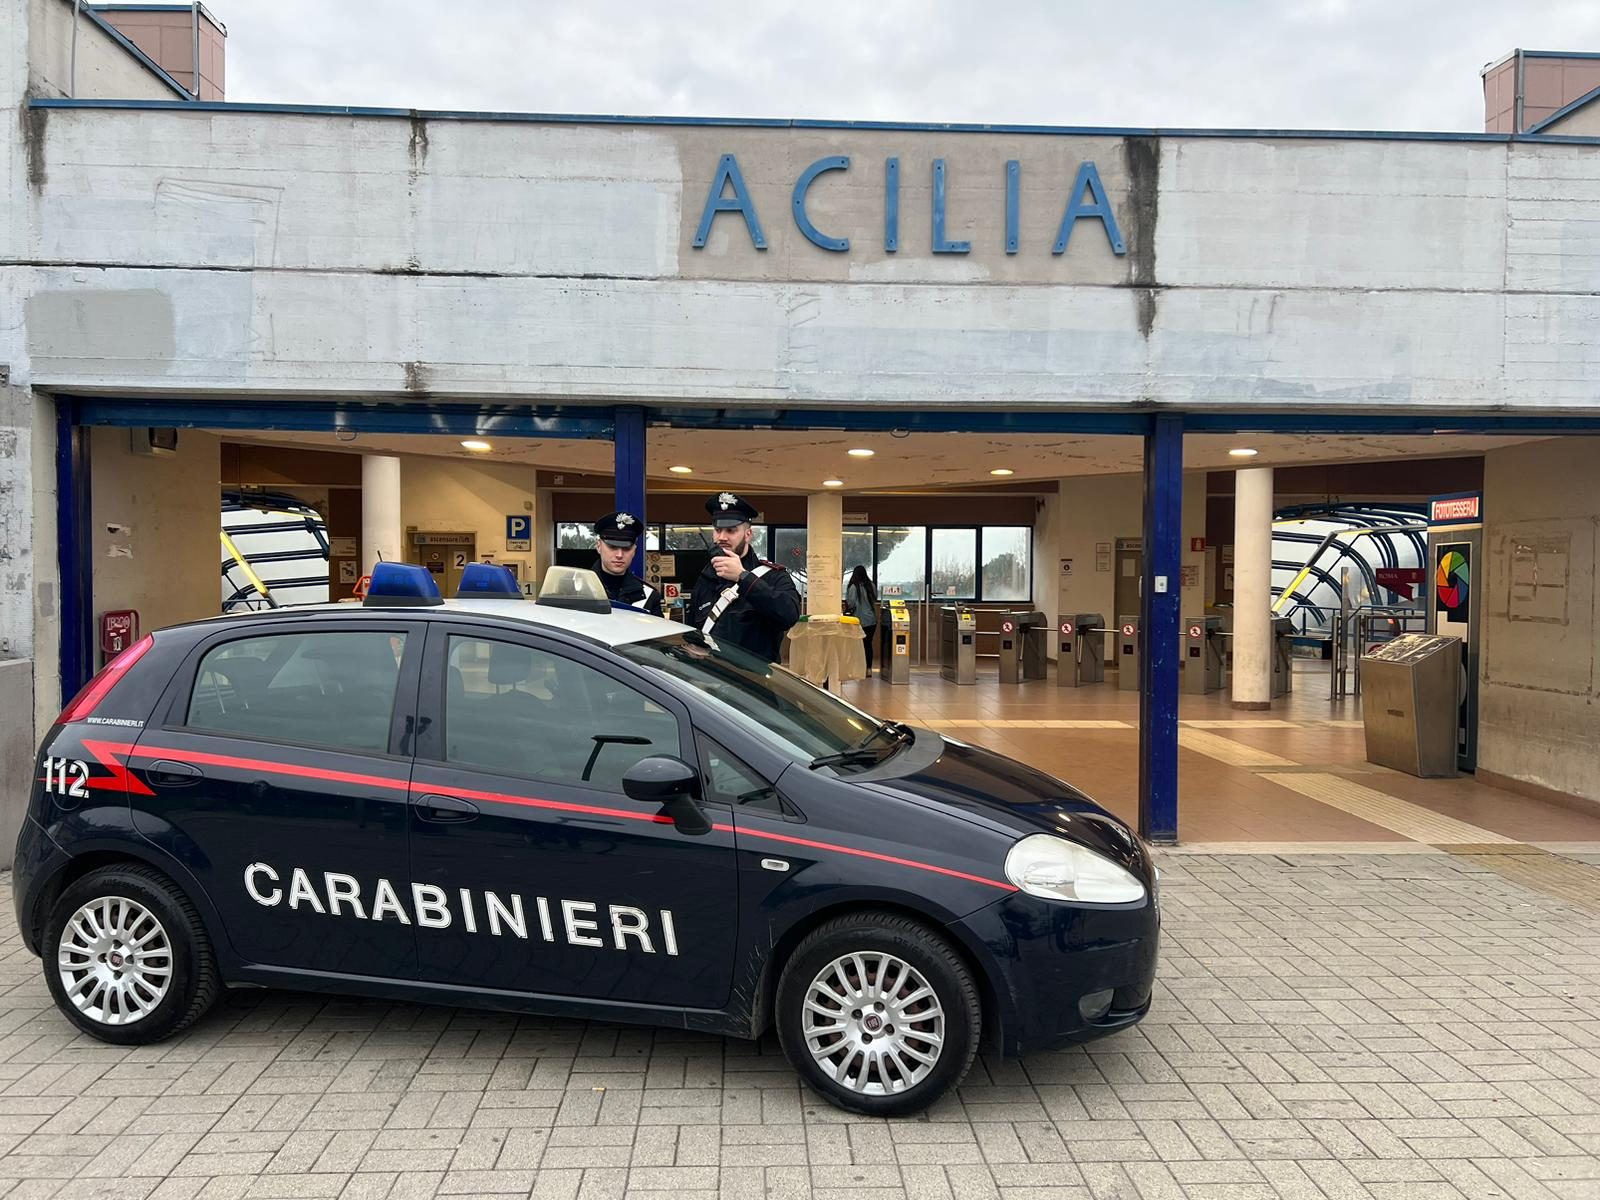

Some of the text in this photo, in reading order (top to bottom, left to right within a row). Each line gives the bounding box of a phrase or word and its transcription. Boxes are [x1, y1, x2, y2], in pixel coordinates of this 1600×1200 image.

[692, 153, 1127, 256] ACILIA
[1435, 501, 1475, 519] FOTOTESSERA
[512, 518, 526, 537] P
[456, 554, 465, 567] 2
[525, 584, 533, 595] 1
[87, 717, 145, 728] WWW.CARABINIERI.IT
[43, 755, 90, 799] 112
[243, 861, 679, 956] CARABINIERI
